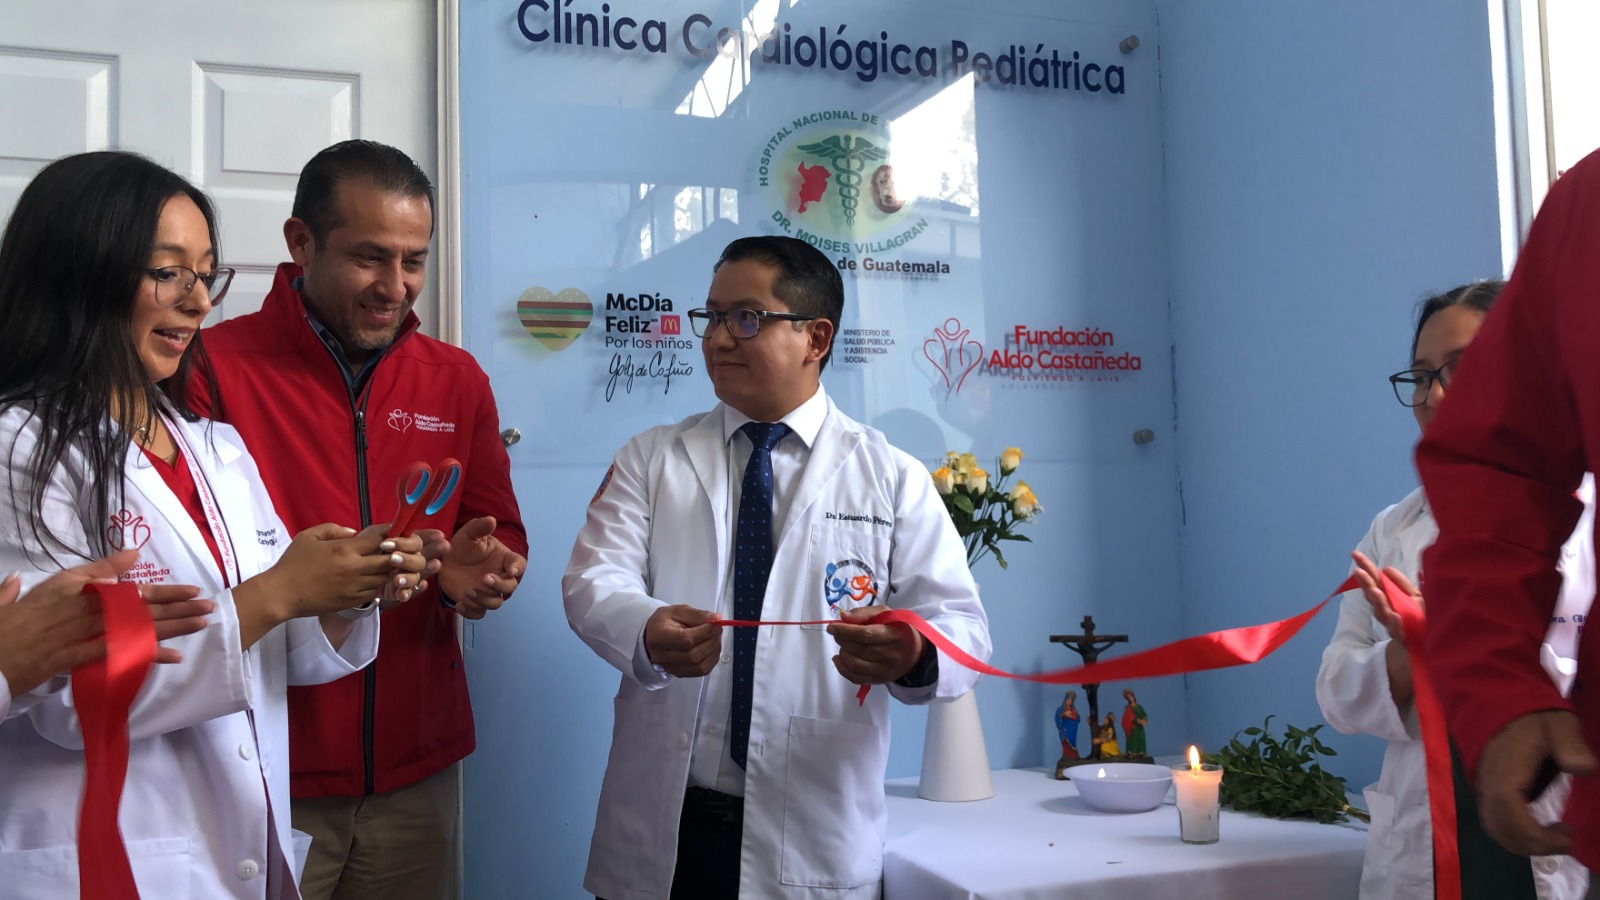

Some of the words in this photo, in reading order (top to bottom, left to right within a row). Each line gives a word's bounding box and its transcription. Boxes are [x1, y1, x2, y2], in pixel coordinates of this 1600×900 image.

[517, 0, 667, 53] Clínica
[682, 13, 937, 82] Cardiológica
[952, 39, 1125, 94] Pediátrica
[759, 127, 792, 187] HOSPITAL
[792, 110, 857, 129] NACIONAL
[861, 113, 879, 125] DE
[771, 210, 792, 234] DR.
[796, 228, 850, 253] MOISES
[855, 218, 929, 254] VILLAGRAN
[837, 257, 857, 270] de
[862, 257, 950, 274] Guatemala
[606, 292, 673, 312] McDía
[606, 315, 652, 333] Feliz
[606, 336, 628, 348] Por
[632, 336, 652, 349] los
[656, 337, 693, 349] niños
[1014, 325, 1114, 346] Fundación
[988, 349, 1034, 368] Aldo
[1037, 350, 1142, 371] Castañeda
